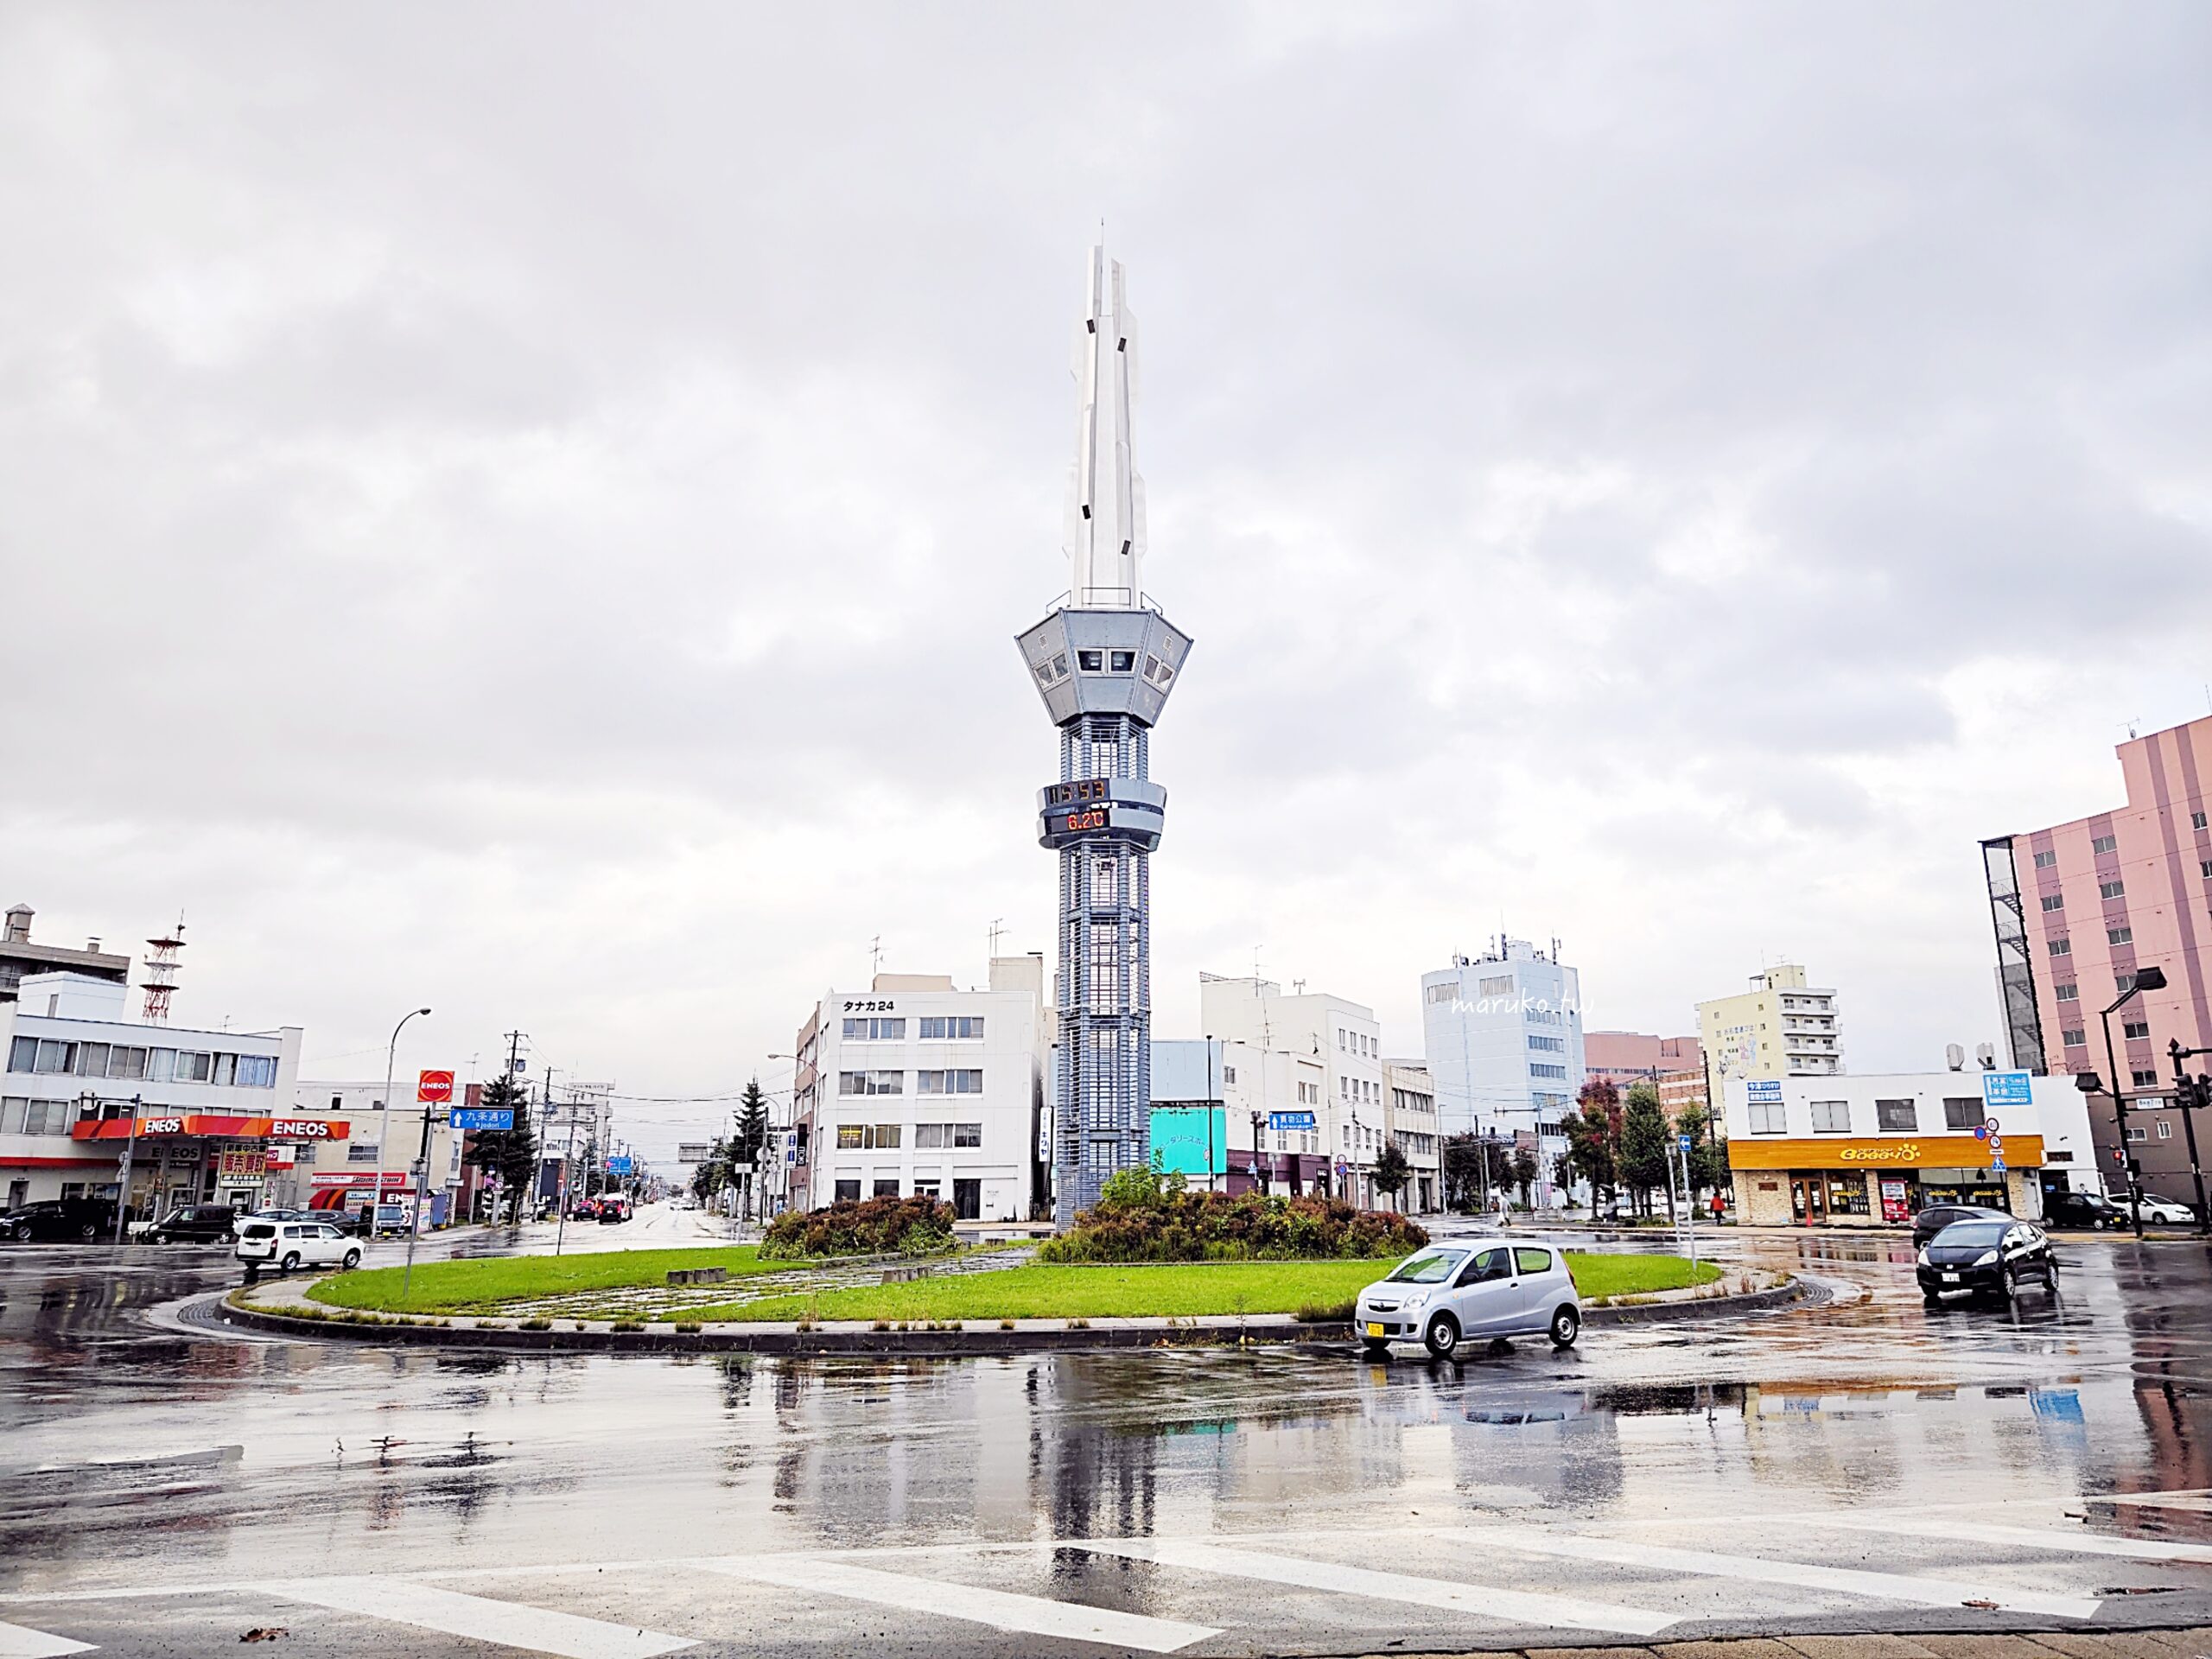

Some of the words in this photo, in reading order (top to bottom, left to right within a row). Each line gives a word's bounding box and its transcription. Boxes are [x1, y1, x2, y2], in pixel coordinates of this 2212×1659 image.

[466, 1111, 510, 1122] 九条通り
[1280, 1115, 1311, 1123] 買物公園
[144, 1118, 181, 1133] ENEOS
[272, 1121, 328, 1136] ENEOS
[225, 1154, 265, 1173] 販売買取
